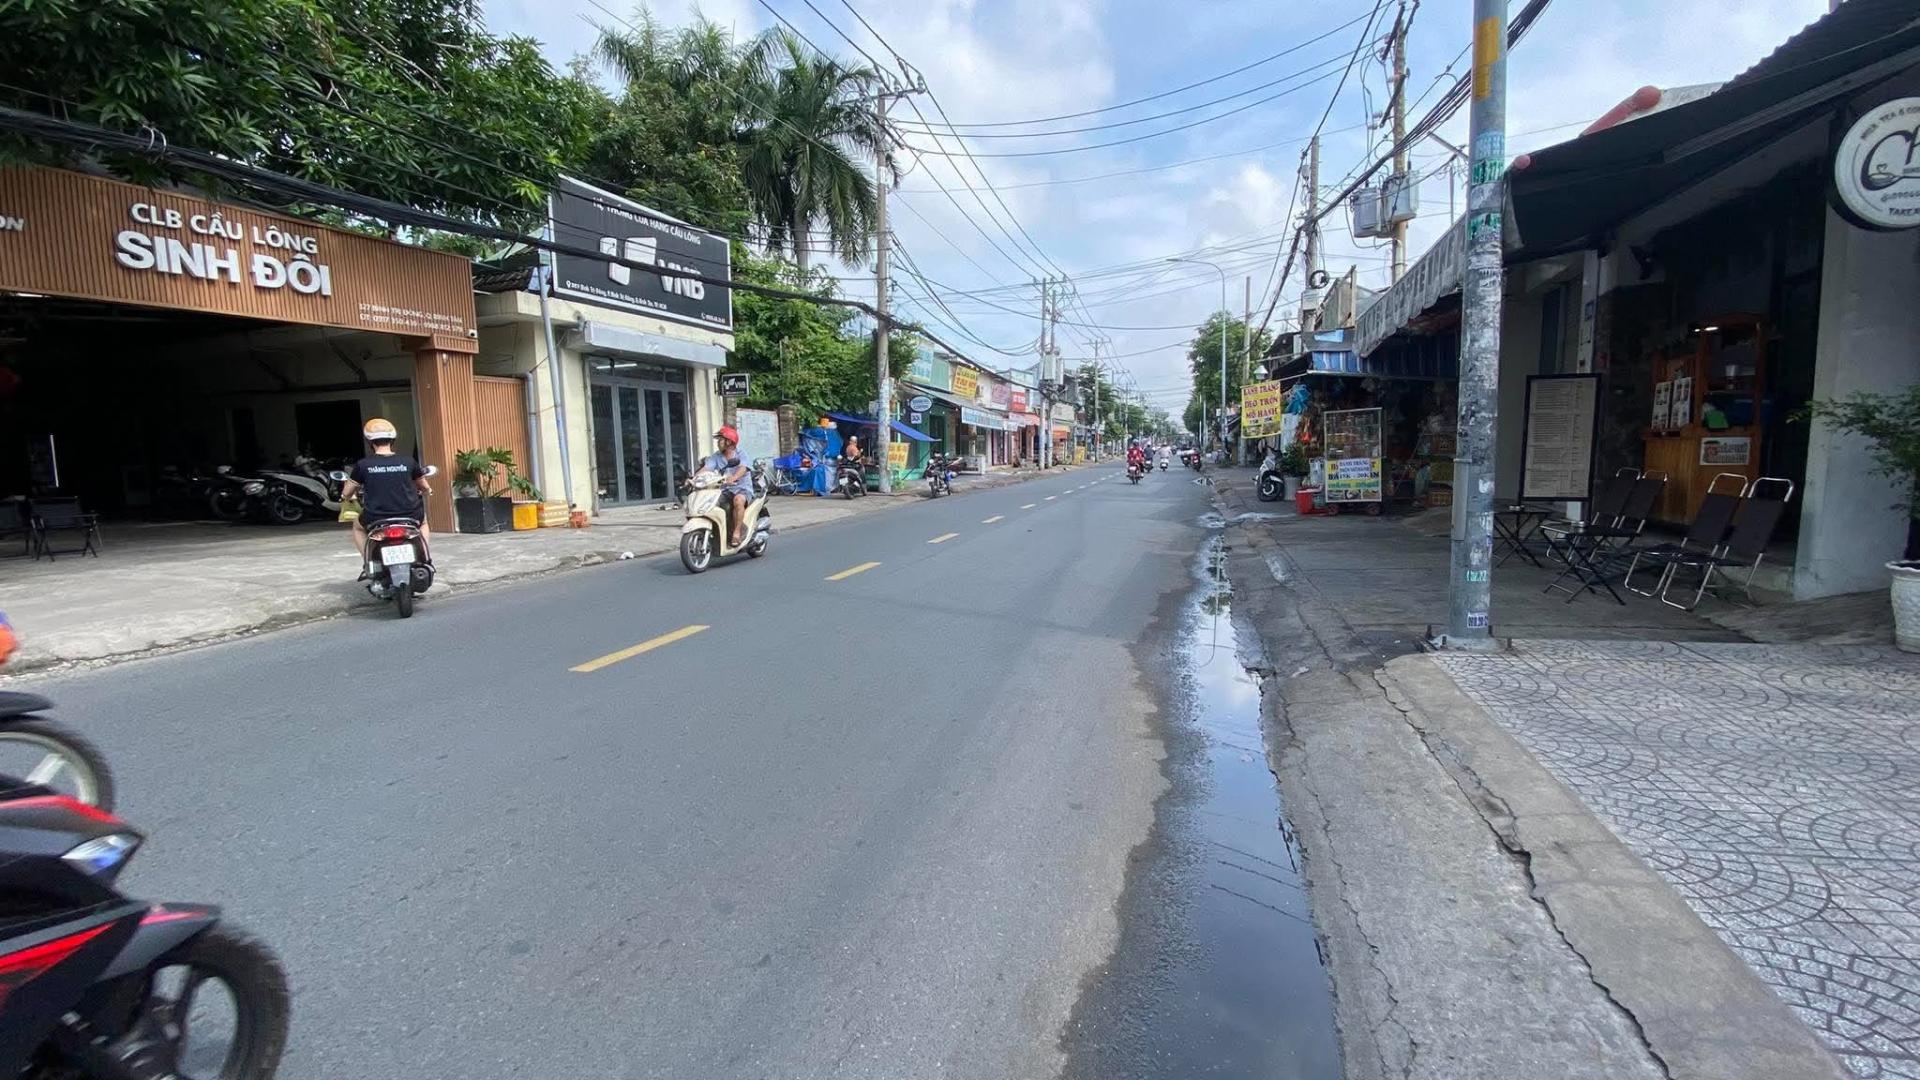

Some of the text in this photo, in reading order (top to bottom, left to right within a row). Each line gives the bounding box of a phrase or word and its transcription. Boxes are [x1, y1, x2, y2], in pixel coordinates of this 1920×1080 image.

[131, 203, 318, 254] CLB CẦU LÔNG
[115, 230, 332, 296] SINH ĐÔI
